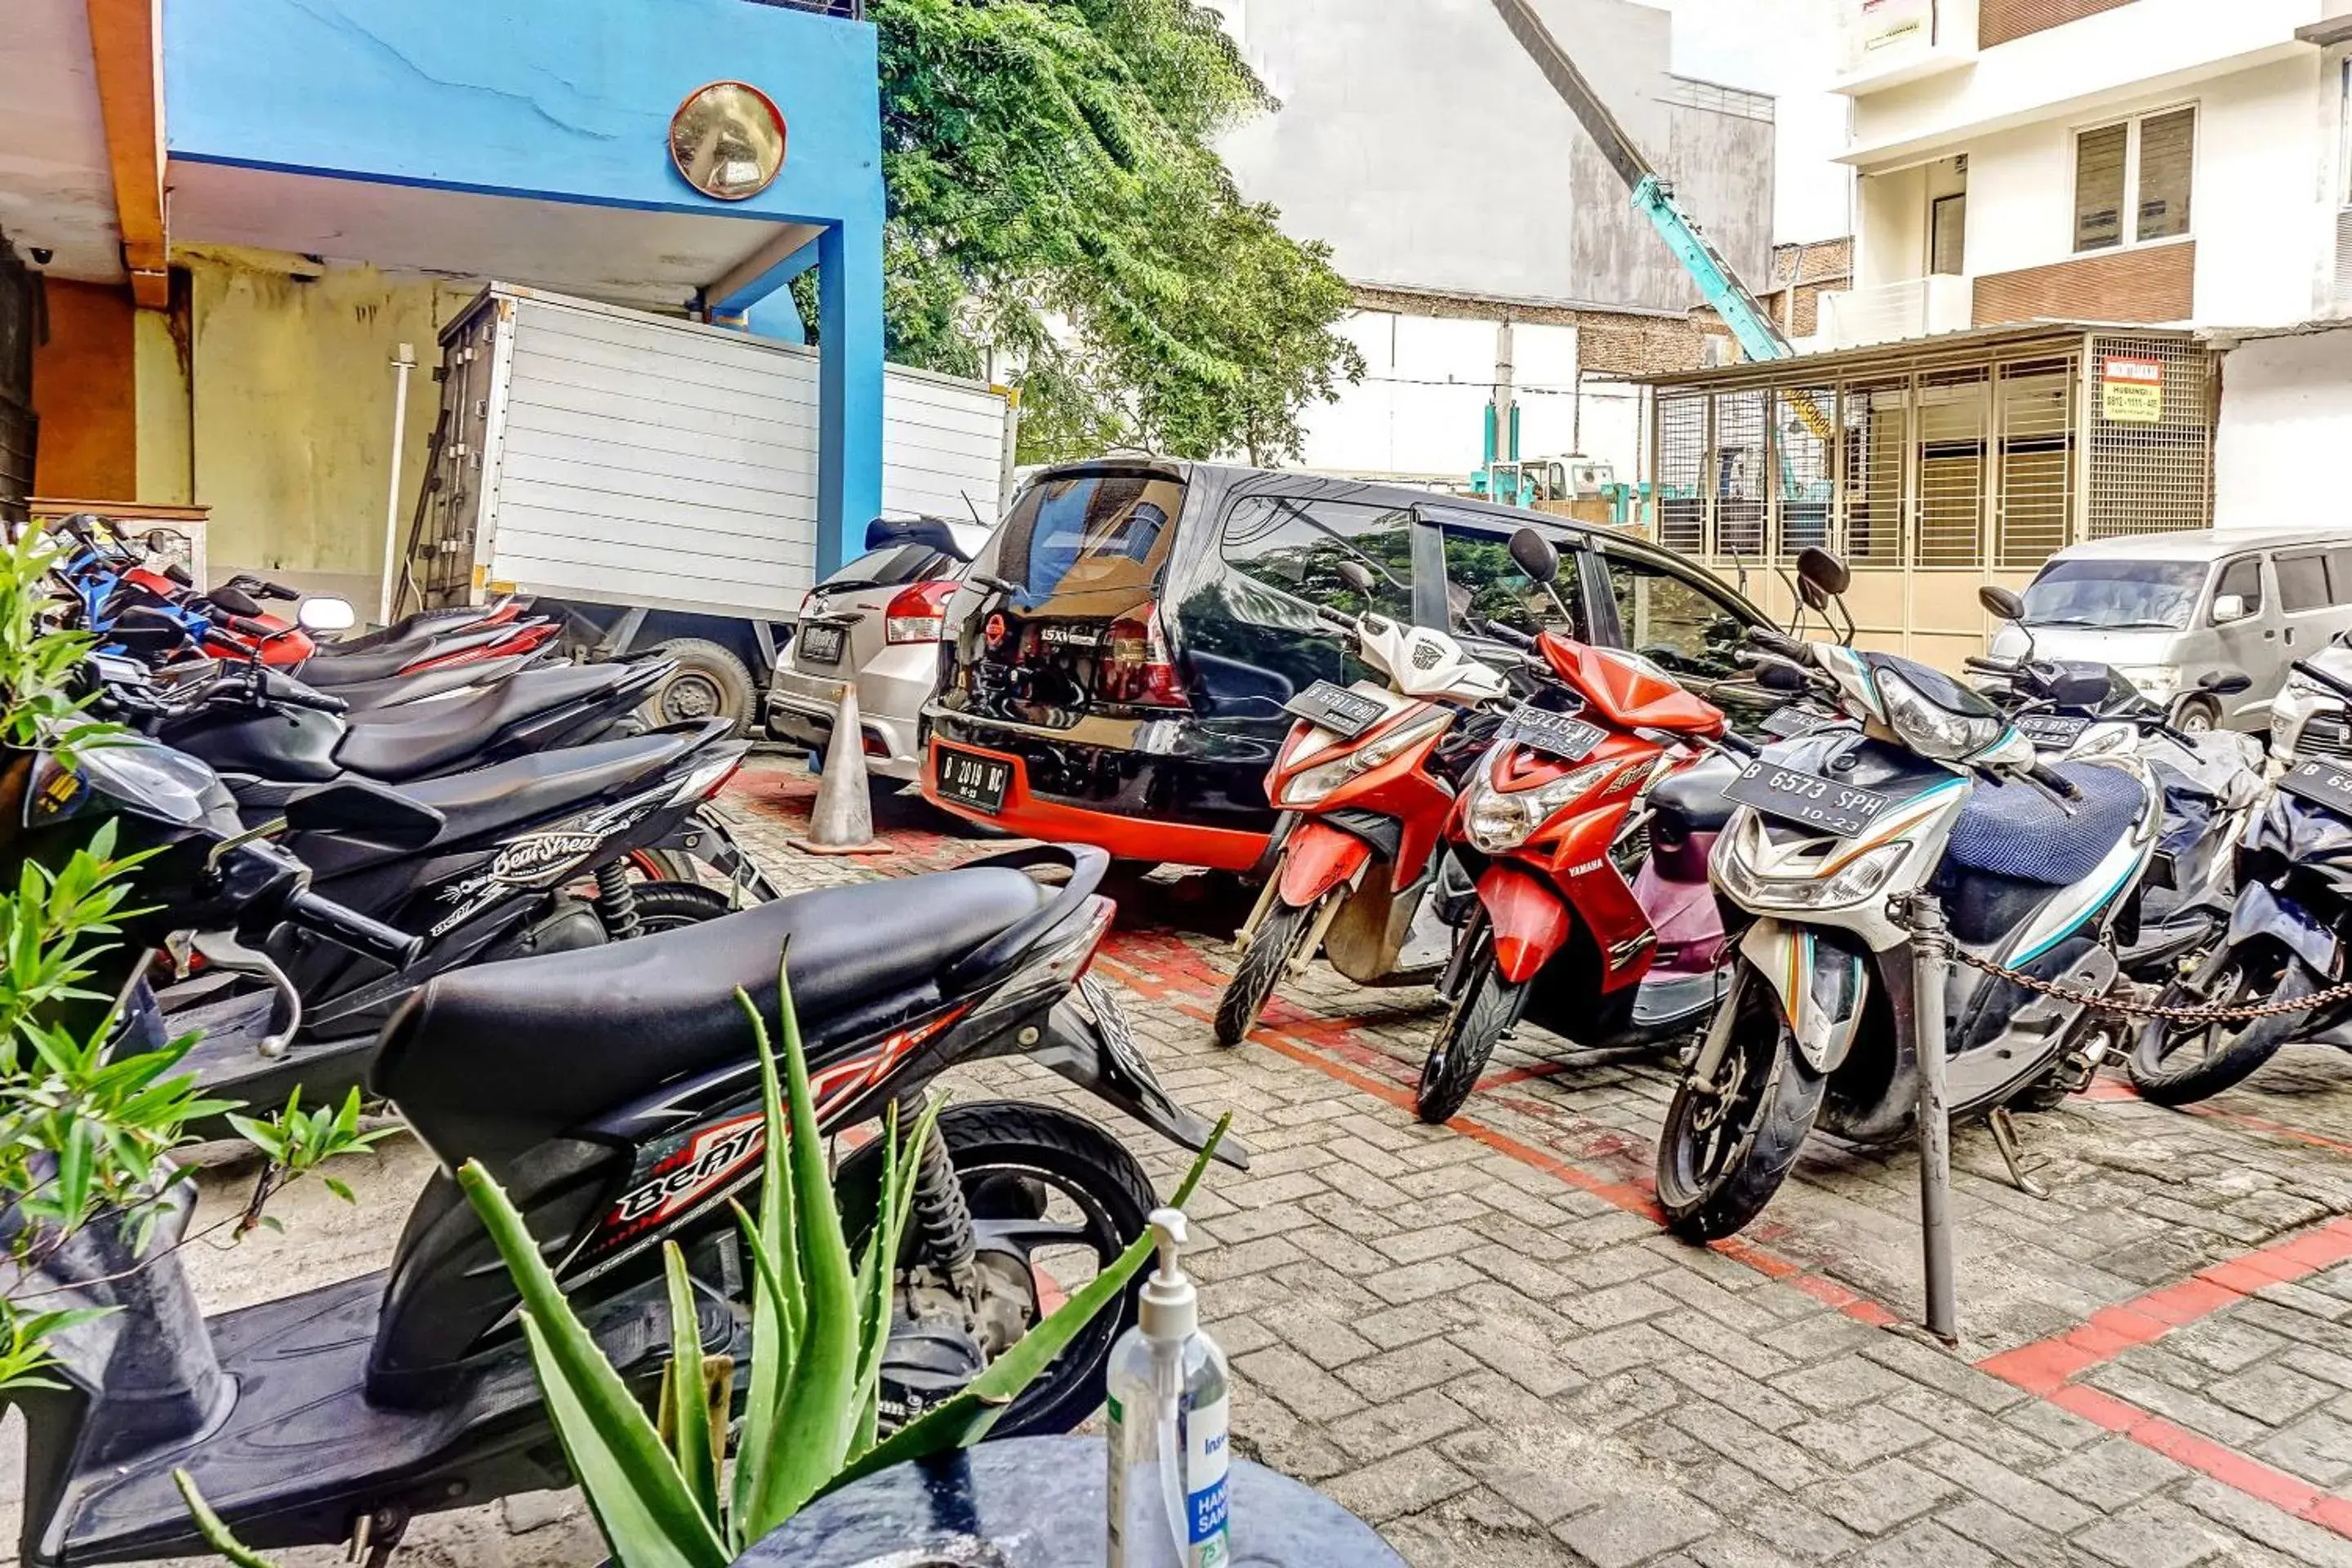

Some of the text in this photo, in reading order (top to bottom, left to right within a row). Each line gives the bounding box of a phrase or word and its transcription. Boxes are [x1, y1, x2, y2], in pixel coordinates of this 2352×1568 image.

[943, 756, 953, 779] B
[957, 760, 982, 787] 2019
[2302, 764, 2320, 776] B
[1742, 763, 1882, 817] B 6573 SPH
[1568, 858, 1603, 878] YAMAHA
[1205, 1433, 1226, 1457] Ins
